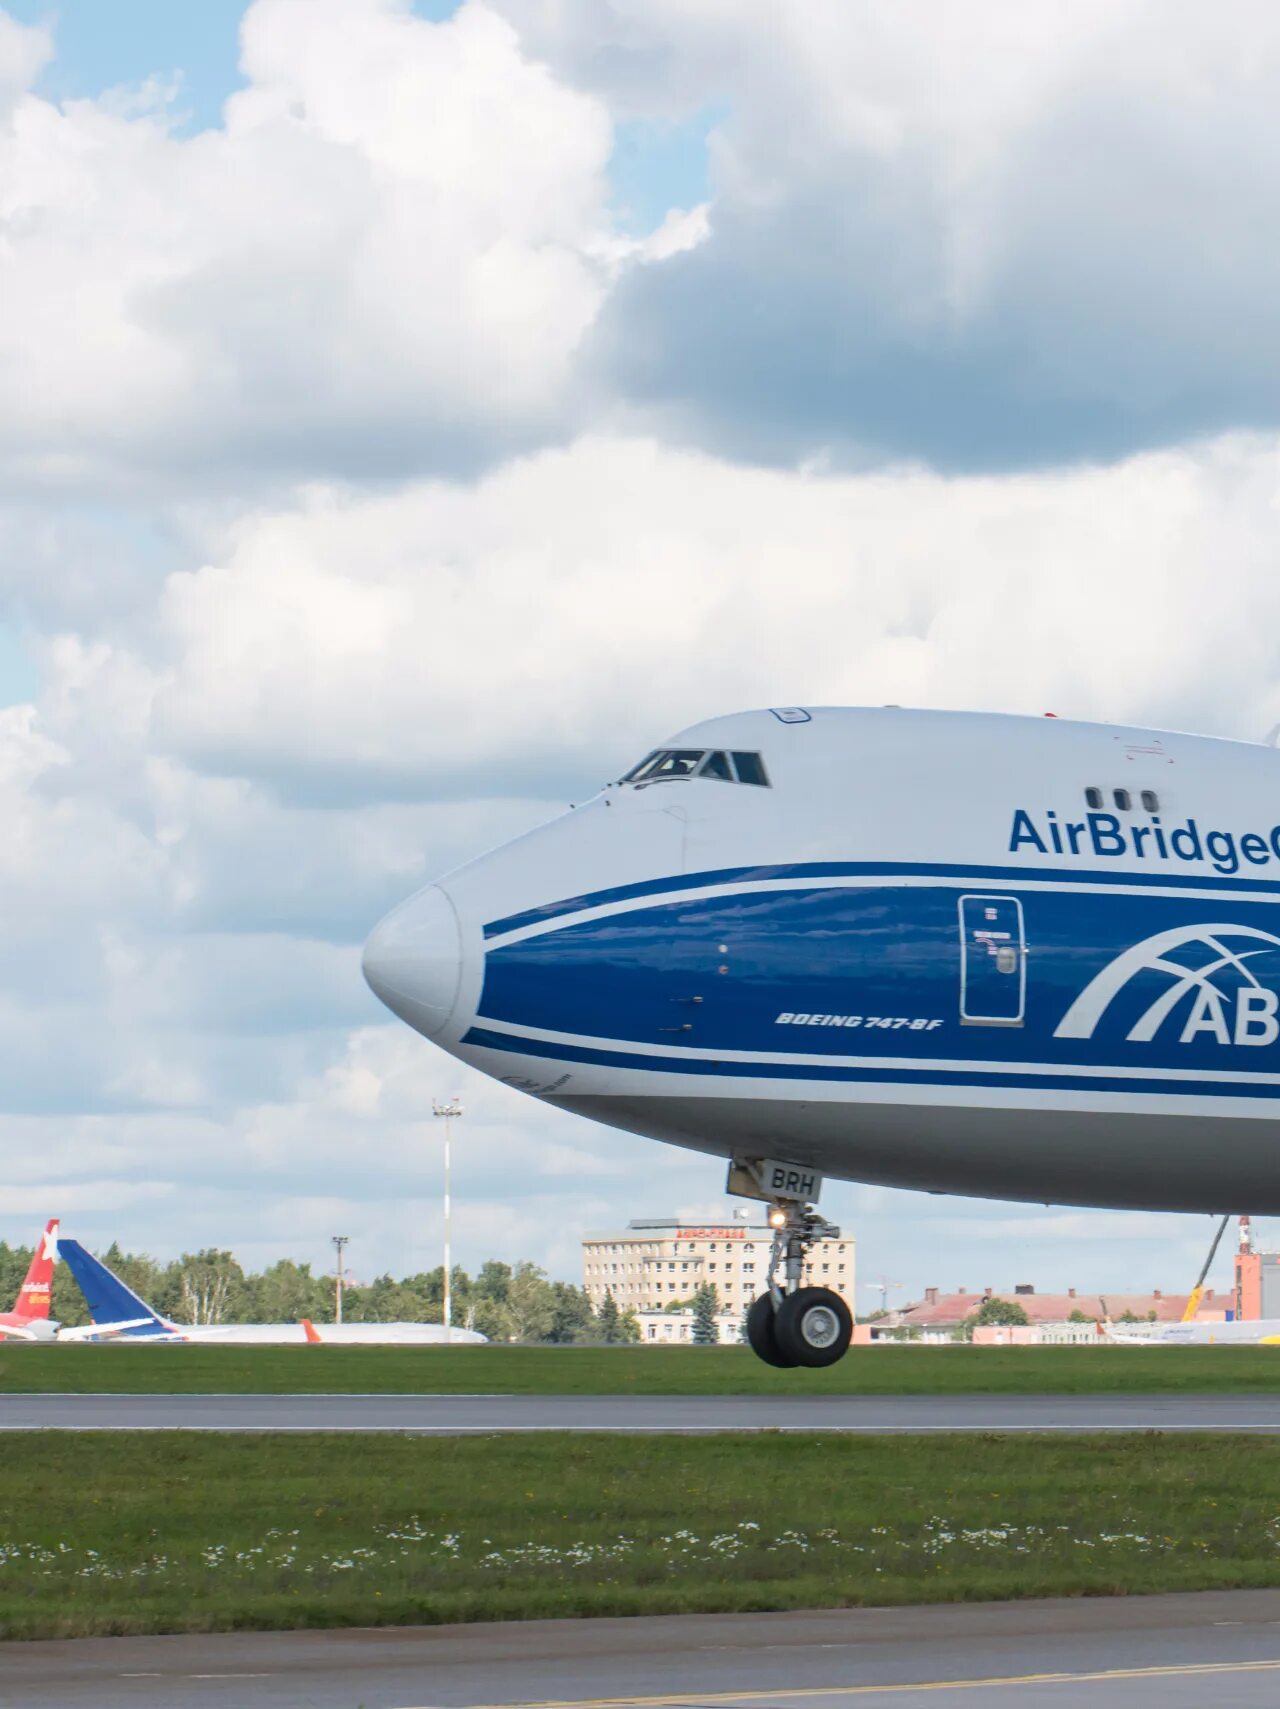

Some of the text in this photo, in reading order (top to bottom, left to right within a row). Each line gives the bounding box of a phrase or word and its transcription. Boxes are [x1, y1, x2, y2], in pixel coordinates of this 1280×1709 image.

[775, 1012, 944, 1030] BOEING 747-8F
[772, 1168, 815, 1196] BRH
